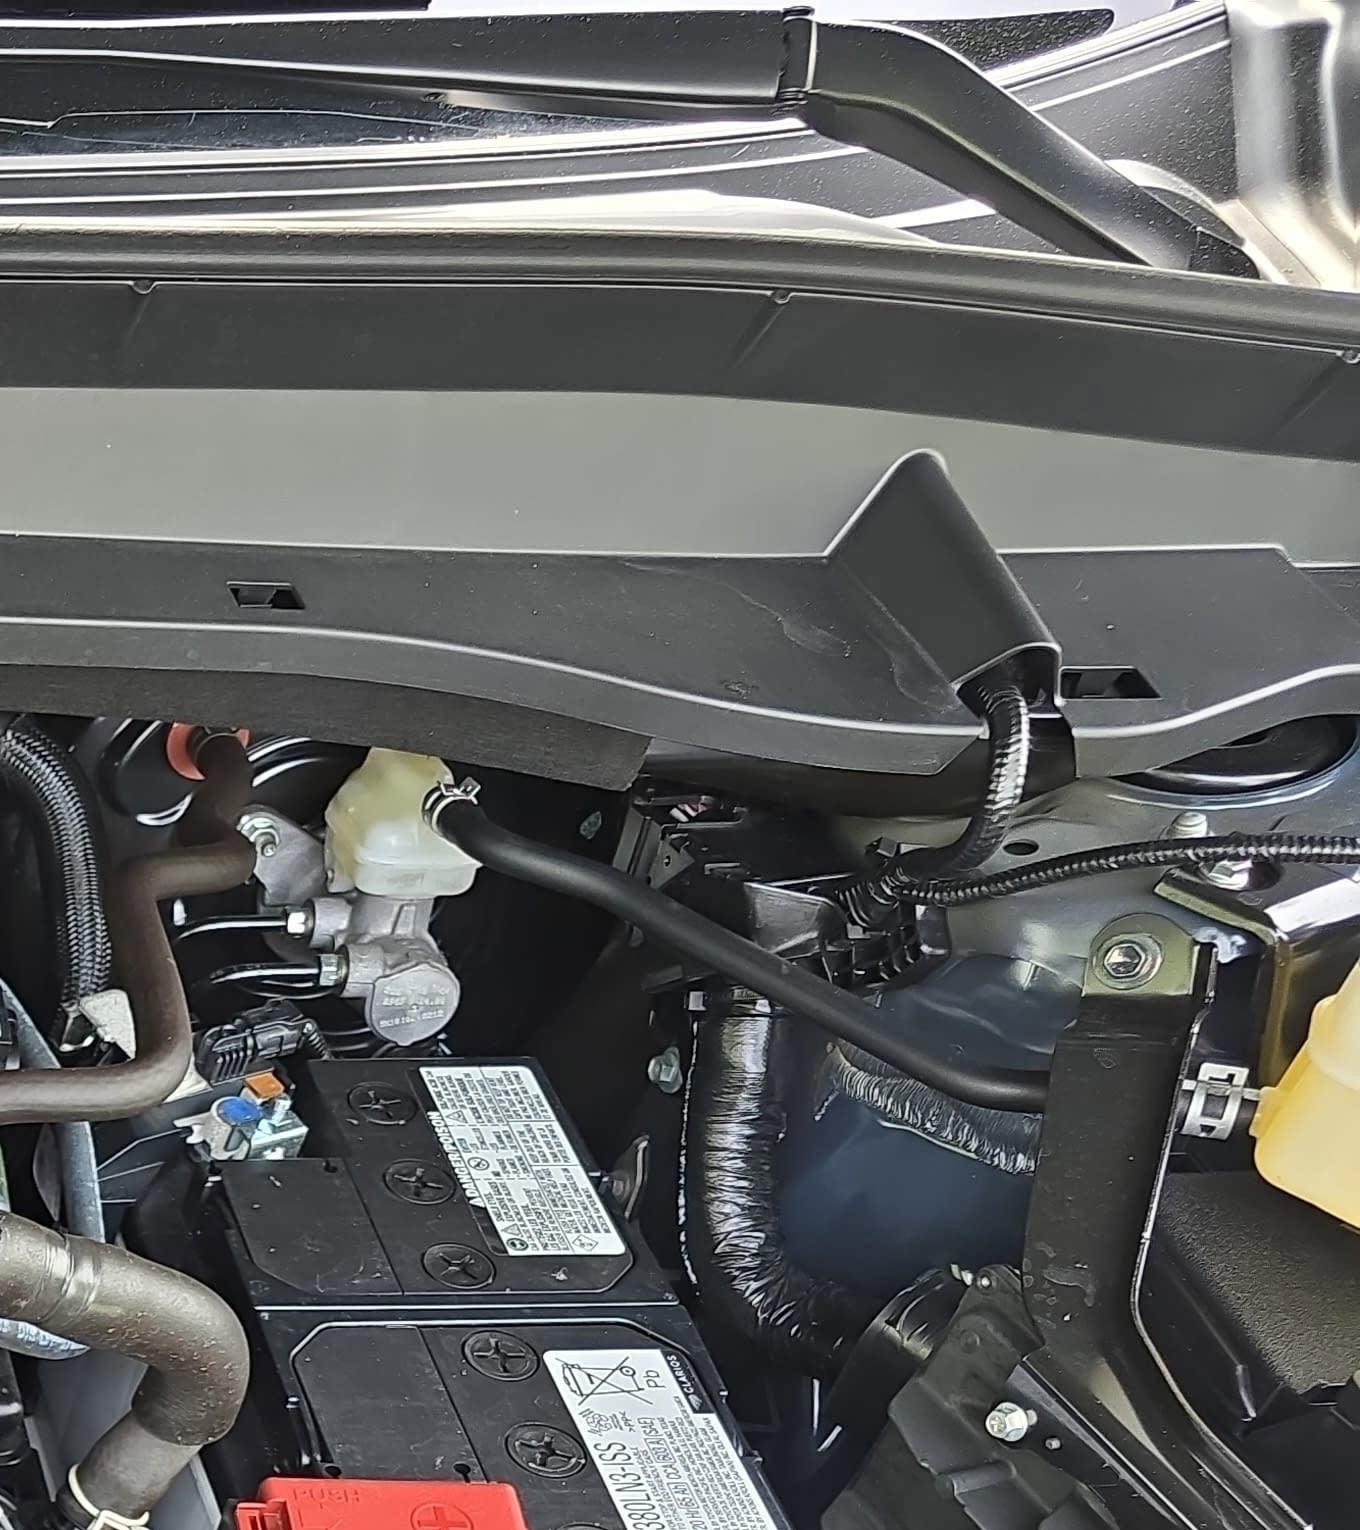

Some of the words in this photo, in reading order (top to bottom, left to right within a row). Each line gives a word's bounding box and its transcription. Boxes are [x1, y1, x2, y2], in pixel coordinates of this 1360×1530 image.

[427, 1111, 476, 1197] DANGER/POISON
[641, 1369, 665, 1388] Pb
[667, 1355, 695, 1394] CLARIOS
[591, 1441, 667, 1530] 380LN3-ISS
[670, 1483, 690, 1494] Ah
[676, 1497, 695, 1506] 65
[683, 1508, 702, 1518] Hr
[689, 1520, 708, 1529] 20
